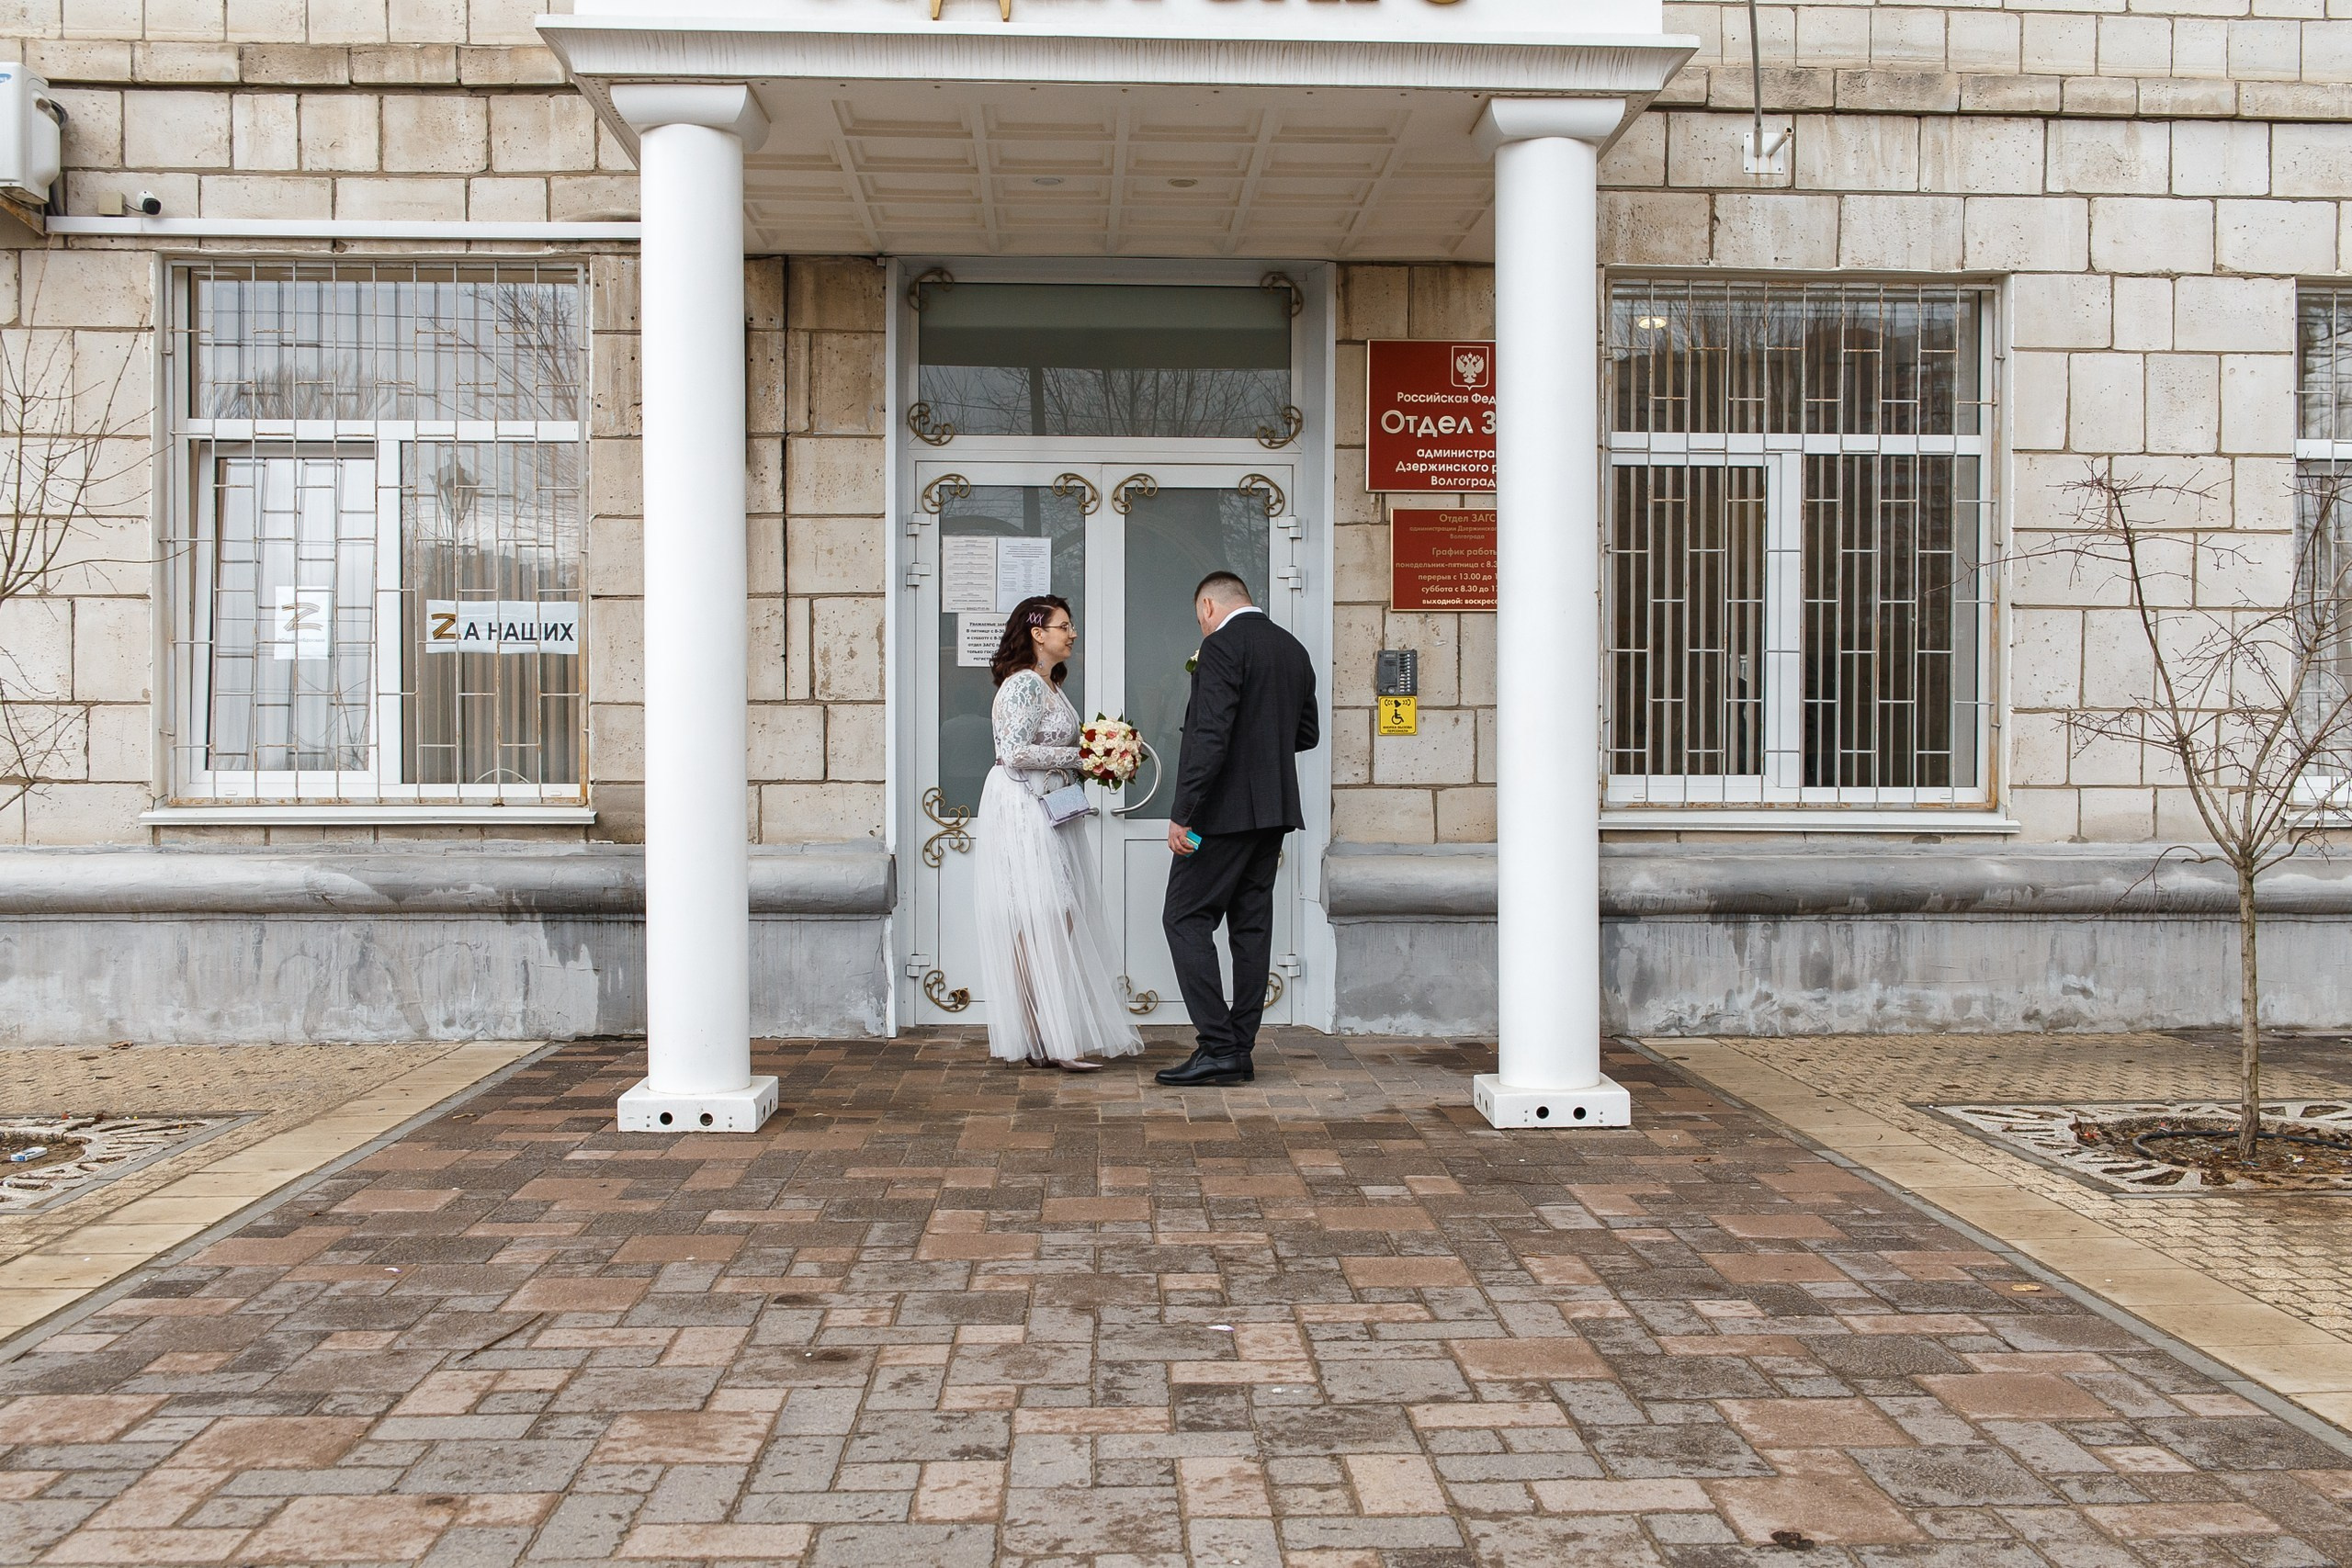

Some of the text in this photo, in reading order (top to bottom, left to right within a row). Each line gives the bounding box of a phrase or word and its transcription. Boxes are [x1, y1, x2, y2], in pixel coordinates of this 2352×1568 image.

[1396, 392, 1468, 403] Российская
[1380, 410, 1474, 438] Отдел
[1417, 448, 1496, 459] администра
[1396, 461, 1489, 473] Дзержинского
[1439, 513, 1497, 523] Отдел ЗАГС
[1431, 547, 1464, 558] График
[1396, 561, 1479, 570] понедельник-пятница
[1418, 574, 1452, 582] перерыв
[1459, 572, 1481, 581] 13.00
[1421, 585, 1453, 594] суббота
[1422, 597, 1463, 605] выходной:
[488, 622, 575, 642] НАШИХ
